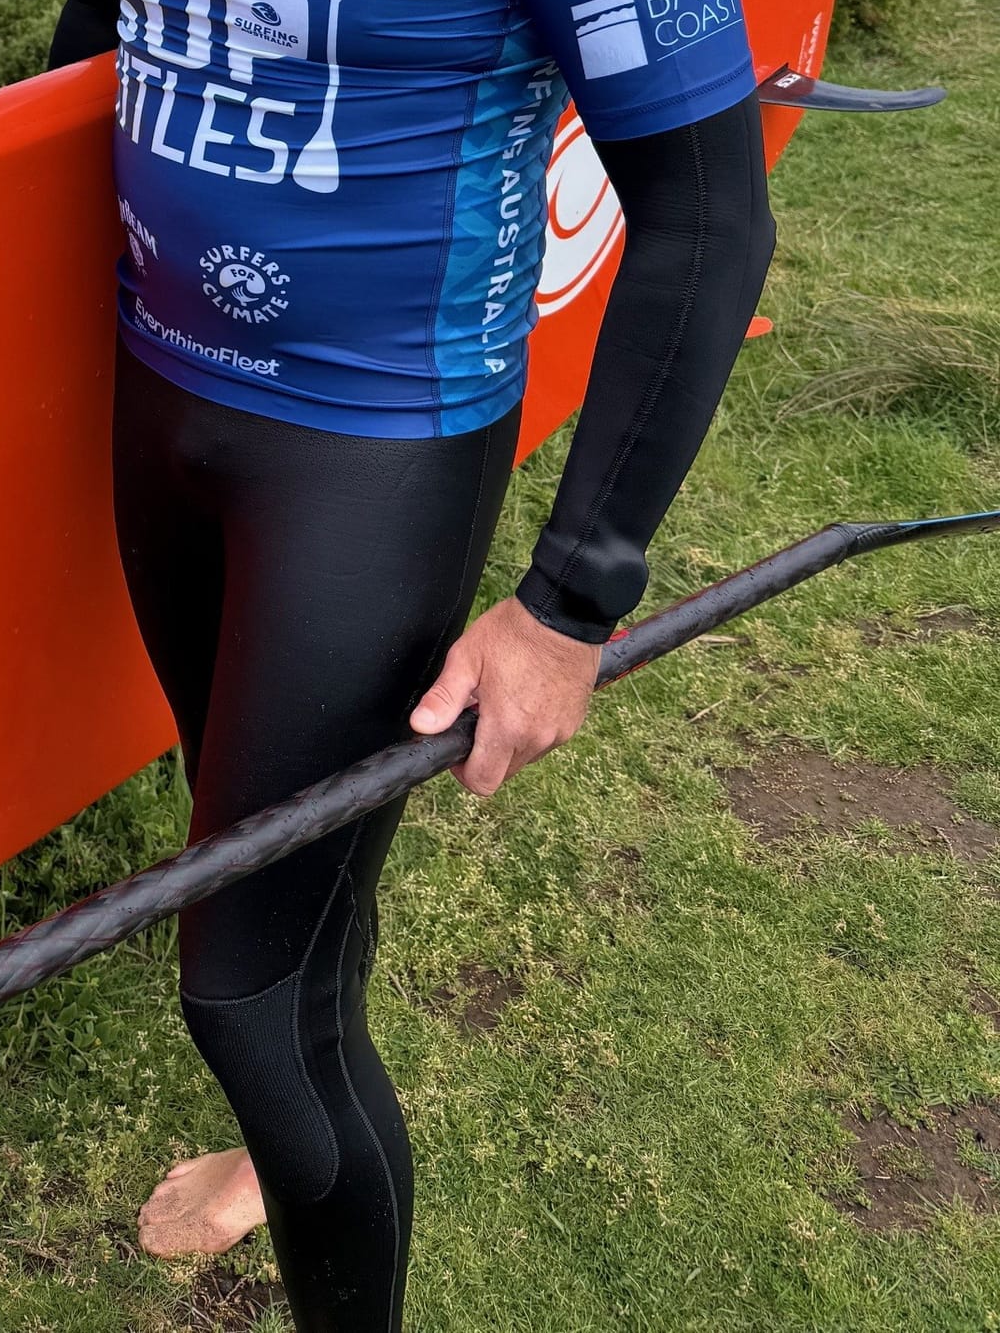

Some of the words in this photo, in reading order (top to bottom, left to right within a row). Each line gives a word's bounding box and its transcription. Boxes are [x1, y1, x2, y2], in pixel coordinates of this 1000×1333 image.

[233, 17, 299, 45] SURFING
[115, 42, 297, 185] ITLES
[199, 244, 291, 286] SURFERS
[230, 268, 256, 282] FOR
[202, 282, 289, 324] CLIMATE
[135, 295, 280, 377] EverythingFleet
